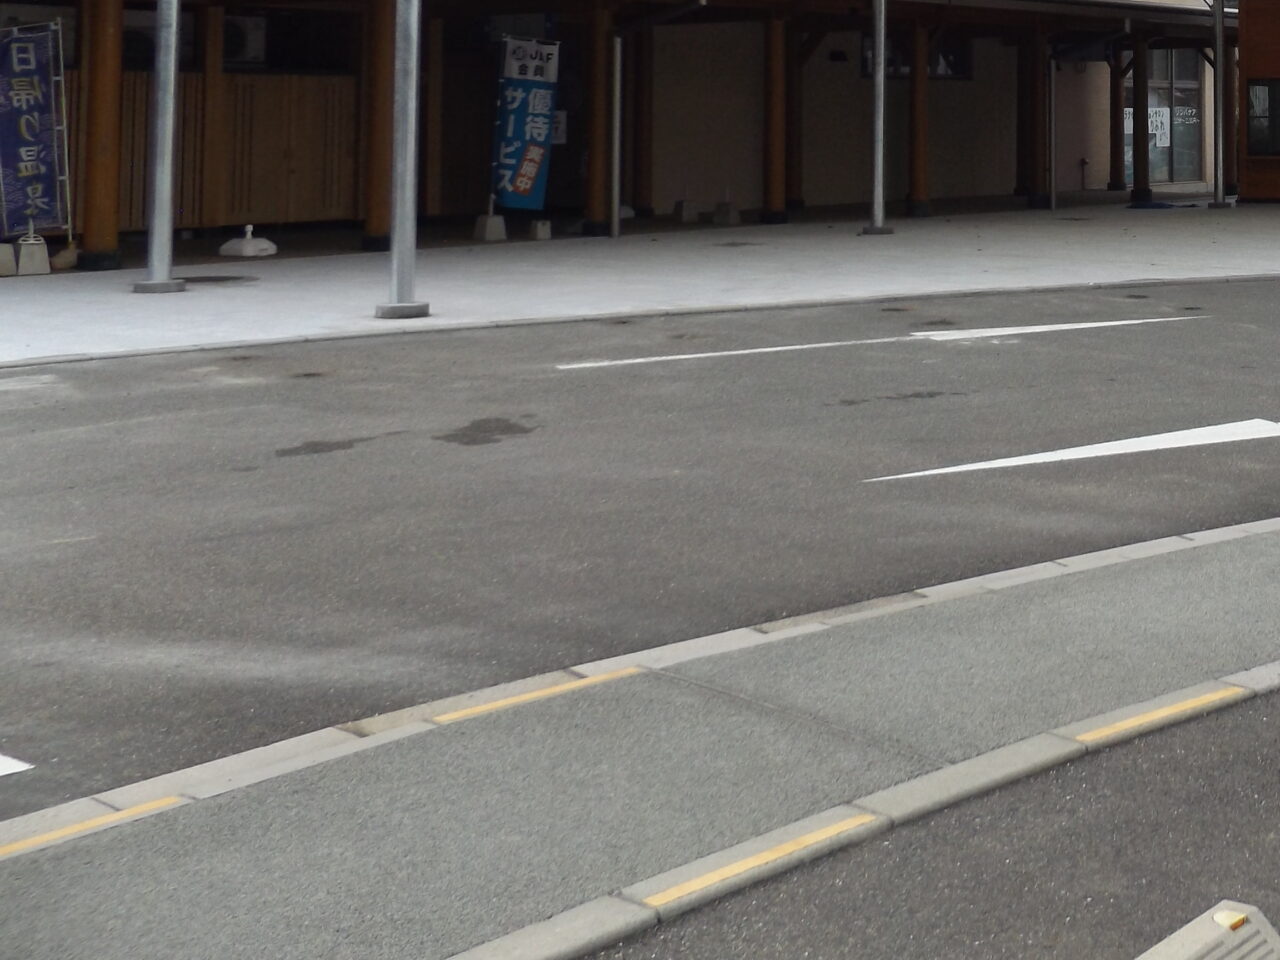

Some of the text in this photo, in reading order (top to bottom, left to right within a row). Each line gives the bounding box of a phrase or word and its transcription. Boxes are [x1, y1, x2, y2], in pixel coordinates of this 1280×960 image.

[498, 88, 525, 192] サービス
[525, 89, 552, 141] 優待
[516, 145, 545, 191] 実施中
